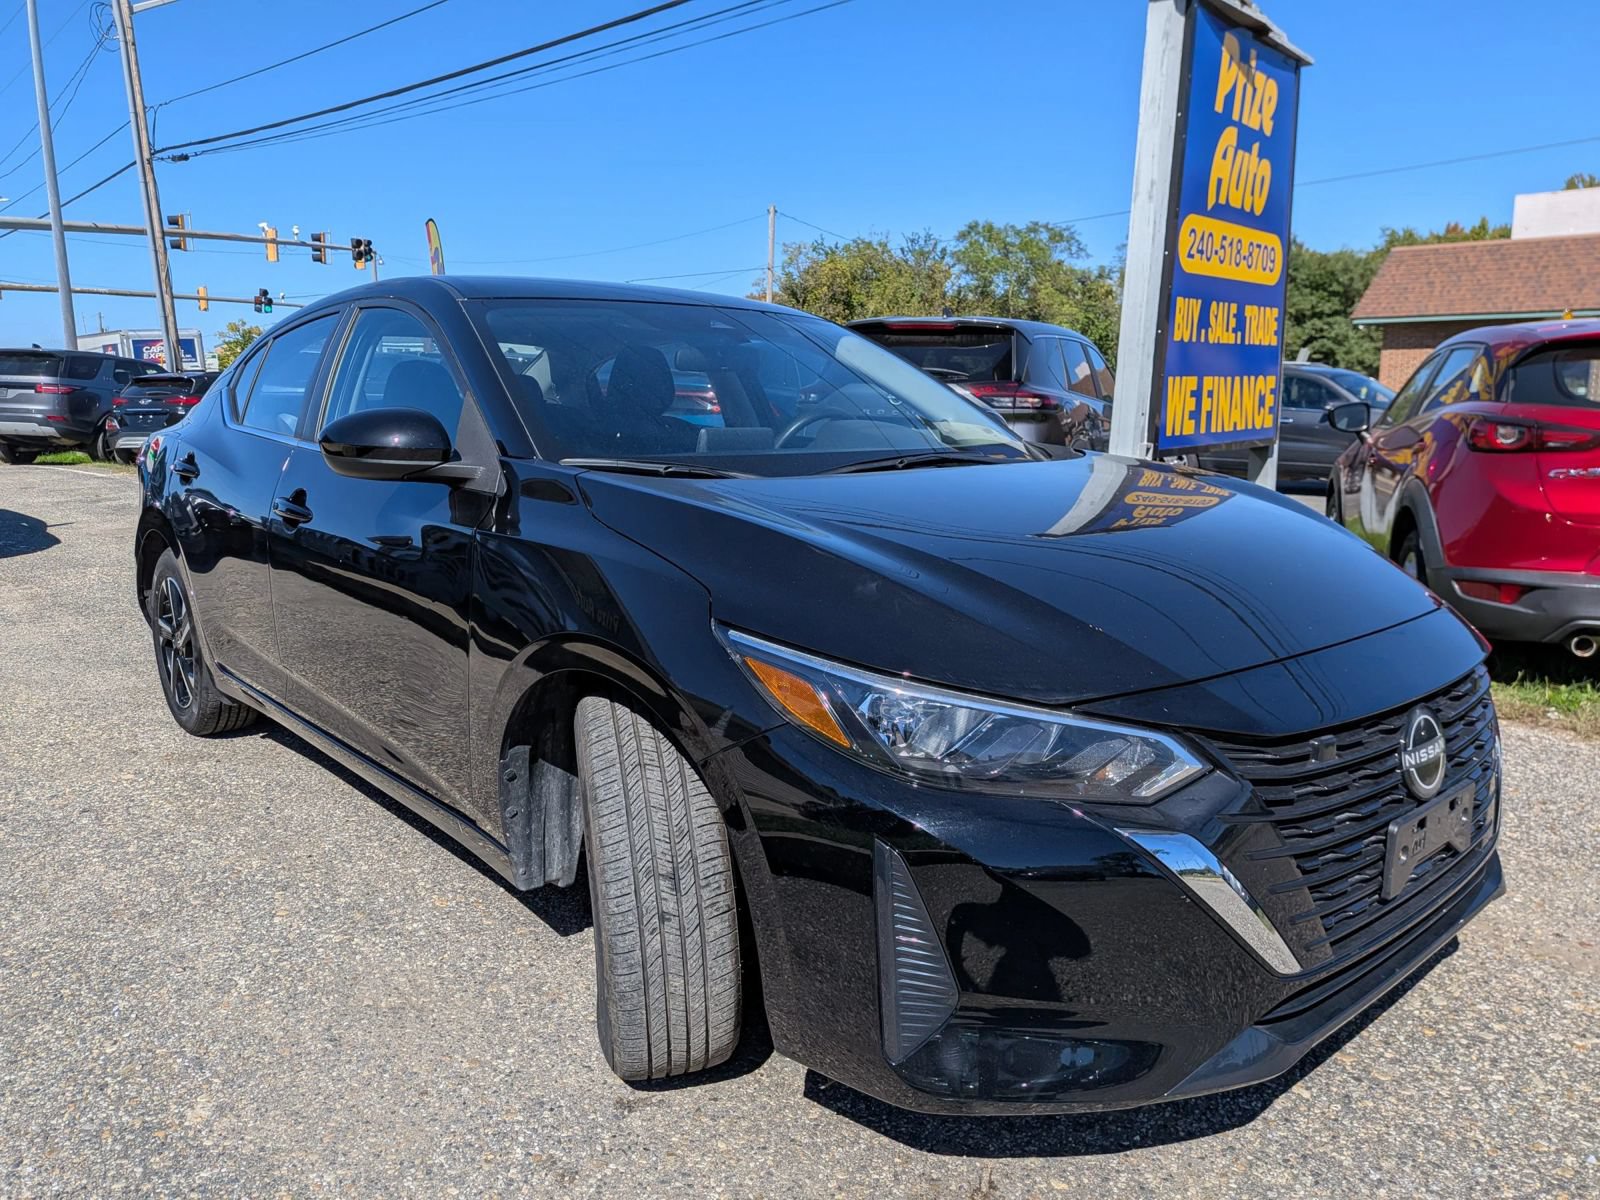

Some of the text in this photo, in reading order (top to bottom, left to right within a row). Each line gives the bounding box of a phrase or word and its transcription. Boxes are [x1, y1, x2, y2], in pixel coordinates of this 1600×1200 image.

[1214, 31, 1278, 137] Prize
[1207, 125, 1271, 217] Auto
[1186, 228, 1276, 273] 240-518-8709
[1244, 304, 1279, 346] TRADE
[1166, 375, 1277, 437] WE FINANCE
[1405, 736, 1446, 767] NISSAN
